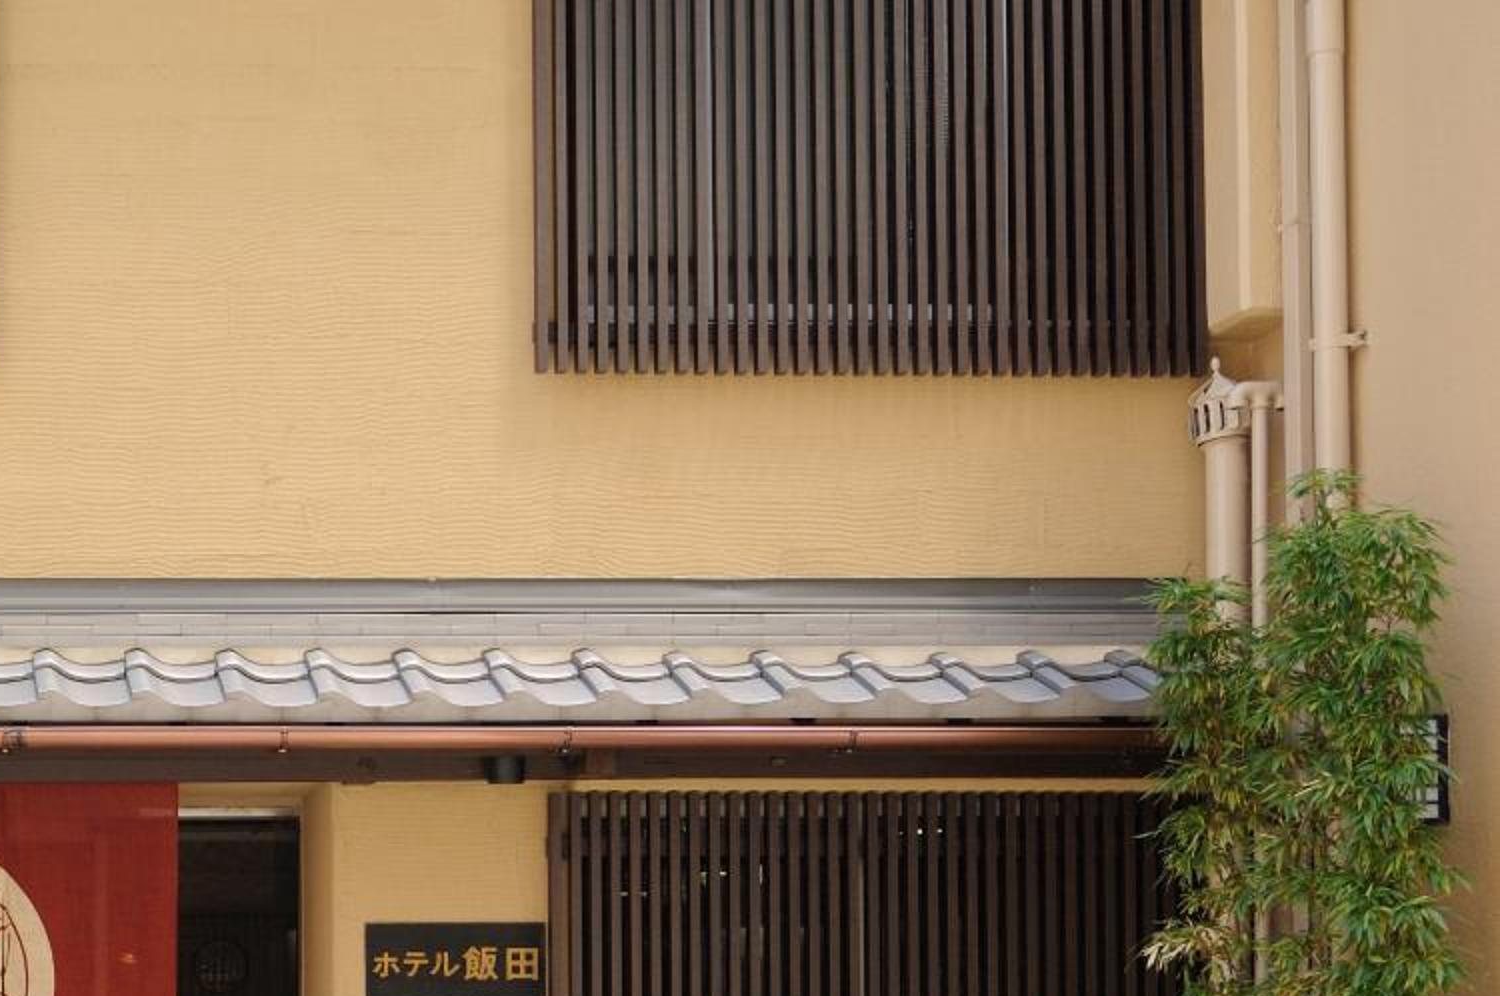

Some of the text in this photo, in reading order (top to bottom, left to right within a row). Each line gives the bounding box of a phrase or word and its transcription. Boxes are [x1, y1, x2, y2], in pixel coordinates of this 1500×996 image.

[372, 946, 539, 981] ホテル飯田
